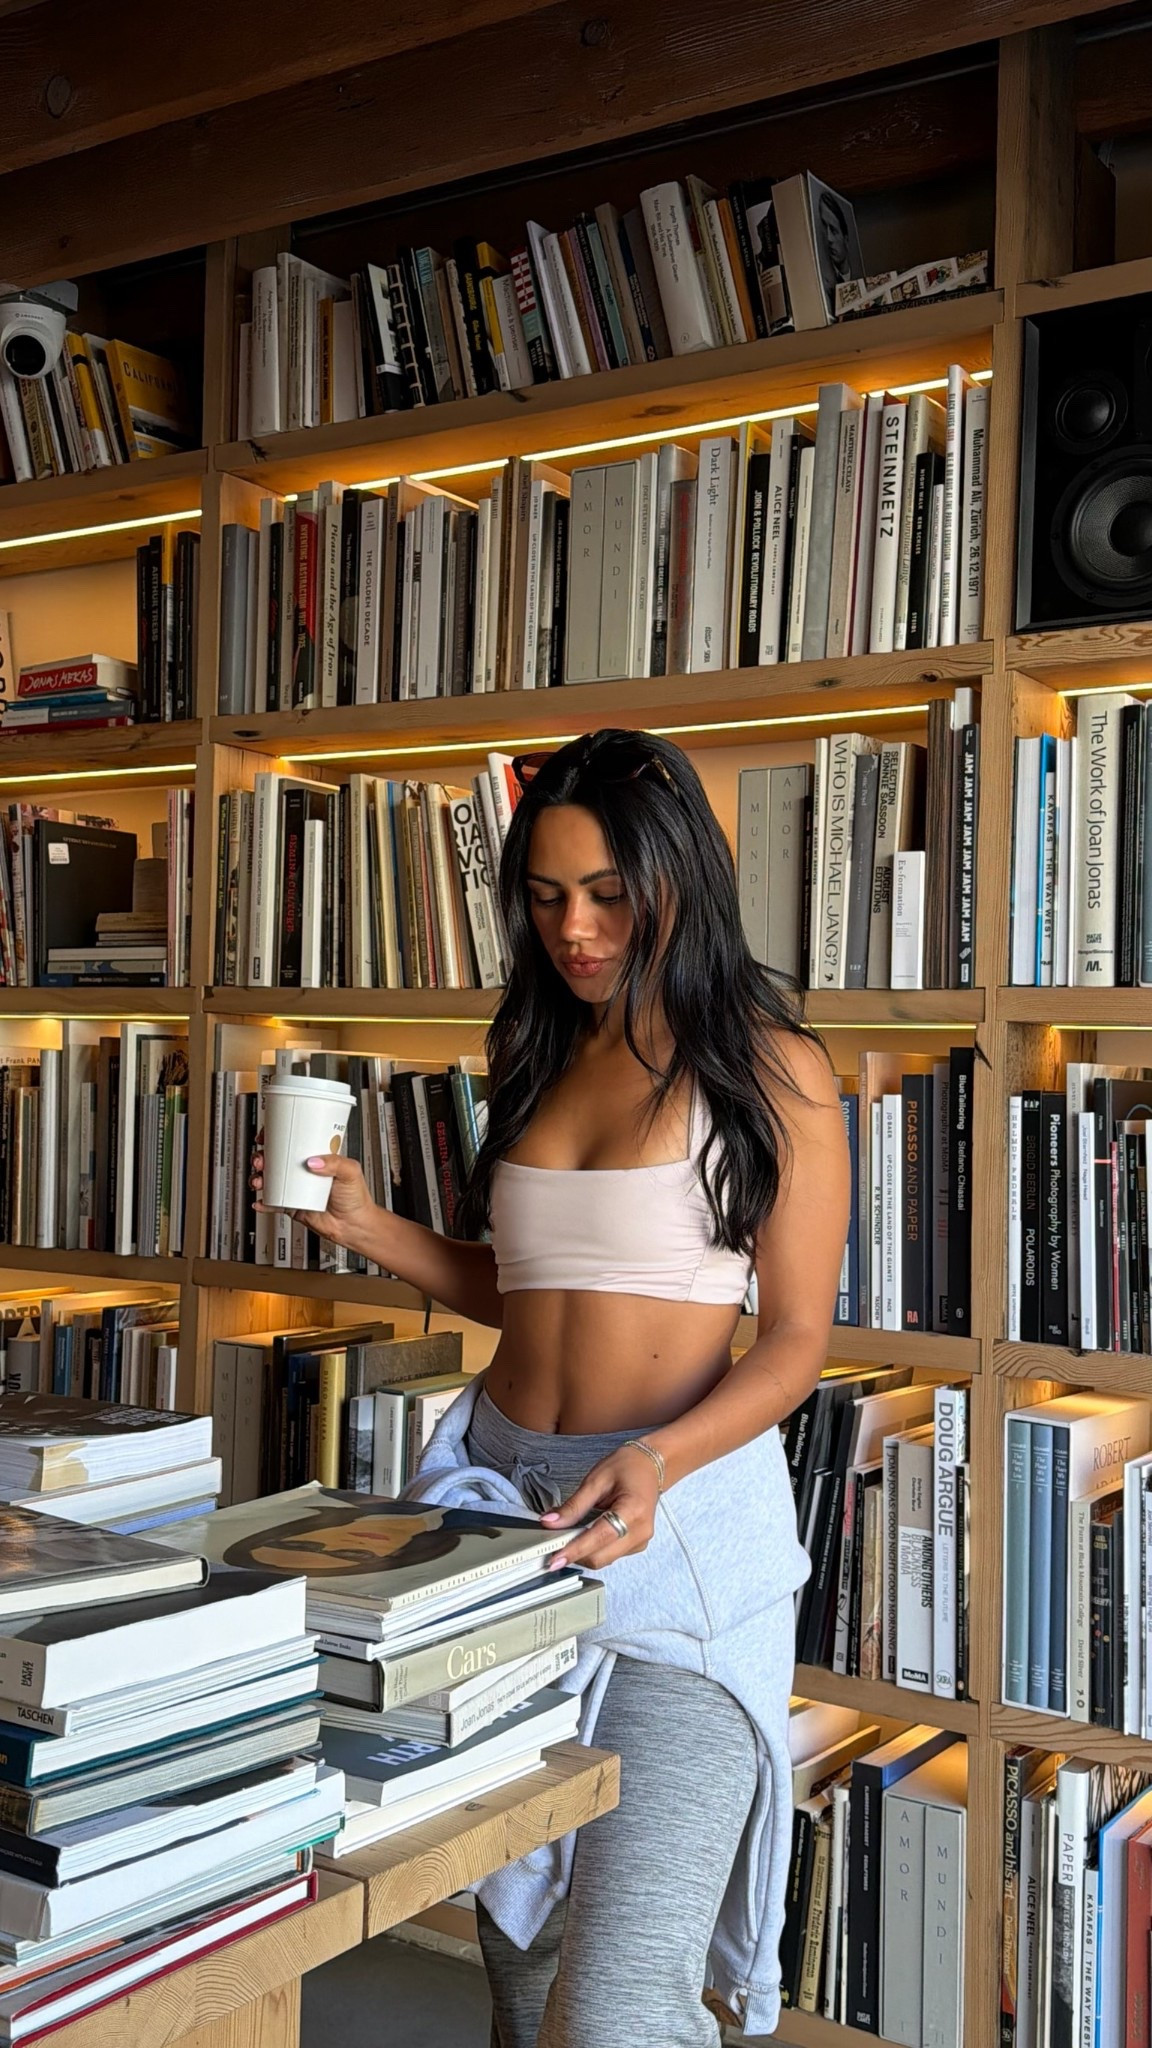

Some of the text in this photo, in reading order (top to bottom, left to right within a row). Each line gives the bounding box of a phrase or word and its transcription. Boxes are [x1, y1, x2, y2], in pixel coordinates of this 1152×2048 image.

[501, 279, 513, 317] Machines
[508, 324, 519, 352] penser
[707, 447, 721, 505] Dark Light
[753, 490, 762, 509] JORN
[845, 465, 854, 493] CELAYA
[879, 416, 900, 538] STEINMETZ
[752, 517, 761, 550] POLLOCK
[772, 485, 783, 540] ALICE NEEL
[967, 428, 985, 598] Muhammad Ali, Zürich, 26.12.1971
[915, 529, 923, 554] SCHLES
[326, 523, 339, 677] Picasso and the Age of Iron
[749, 552, 760, 608] REVOLUTIONARY
[363, 611, 371, 646] DECADE
[748, 609, 757, 633] ROADS
[910, 612, 918, 633] STEIDL
[878, 751, 891, 839] RONNIE SASSOON
[888, 751, 899, 806] SELECTION
[782, 777, 792, 859] AMOR
[1086, 710, 1108, 909] The Work of Joan Jonas
[749, 803, 760, 907] MUNDI
[824, 739, 848, 966] WHO IS MICHAEL JANG?
[960, 751, 974, 942] JAM JAM JAM JAM JAM JAM JAM JAM
[1044, 794, 1054, 939] KAYAFAS THE WAY WEST
[285, 834, 298, 934] SEMINA CULTURE
[873, 866, 884, 914] EDITIONS
[882, 866, 892, 905] AUGUST
[896, 859, 907, 917] Ex-formation
[5, 1056, 25, 1064] Frank
[887, 1112, 893, 1121] JO
[887, 1154, 893, 1164] UP
[907, 1100, 918, 1241] PICASSO AND PAPER
[957, 1140, 967, 1173] Stefano
[887, 1187, 893, 1195] IN
[957, 1174, 967, 1211] Chiassai
[1046, 1113, 1061, 1290] Pioneers Photography by Women
[887, 1231, 893, 1241] OF
[1025, 1228, 1036, 1286] POLAROIDS
[906, 1310, 919, 1323] RA
[320, 1402, 328, 1441] RIVERA
[791, 1413, 809, 1467] BlueTailoring
[938, 1402, 954, 1537] DOUG ARGUE
[1093, 1436, 1132, 1470] ROBERT
[887, 1454, 896, 1650] JOAN JONAS: GOOD NIGHT GOOD MORNING
[900, 1532, 911, 1575] AT MoMA
[1077, 1525, 1085, 1543] Farm
[911, 1534, 922, 1588] BLACKNESS
[921, 1535, 933, 1608] AMONG OTHERS
[942, 1573, 949, 1582] TO
[1077, 1552, 1085, 1571] Black
[941, 1597, 949, 1622] FUTURE
[1077, 1571, 1085, 1602] Mountain
[1076, 1603, 1085, 1628] College
[20, 1660, 31, 1686] HATJE
[25, 1661, 34, 1687] CANTZ
[446, 1642, 497, 1680] Cars
[902, 1669, 928, 1682] MoMA
[1077, 1639, 1085, 1679] David Silver
[17, 1706, 55, 1726] TASCHEN
[460, 1701, 495, 1731] Joan Jonas
[899, 1810, 910, 1902] AMOR
[1004, 1764, 1019, 1900] PICASSO and his art
[1062, 1833, 1075, 1883] PAPER
[936, 1845, 948, 1965] MUNDI
[1026, 1875, 1037, 1937] ALICE NEEL
[1003, 1915, 1013, 1975] Denis Thomas
[1083, 1893, 1094, 2048] KAYAFAS THE WAY WEST
